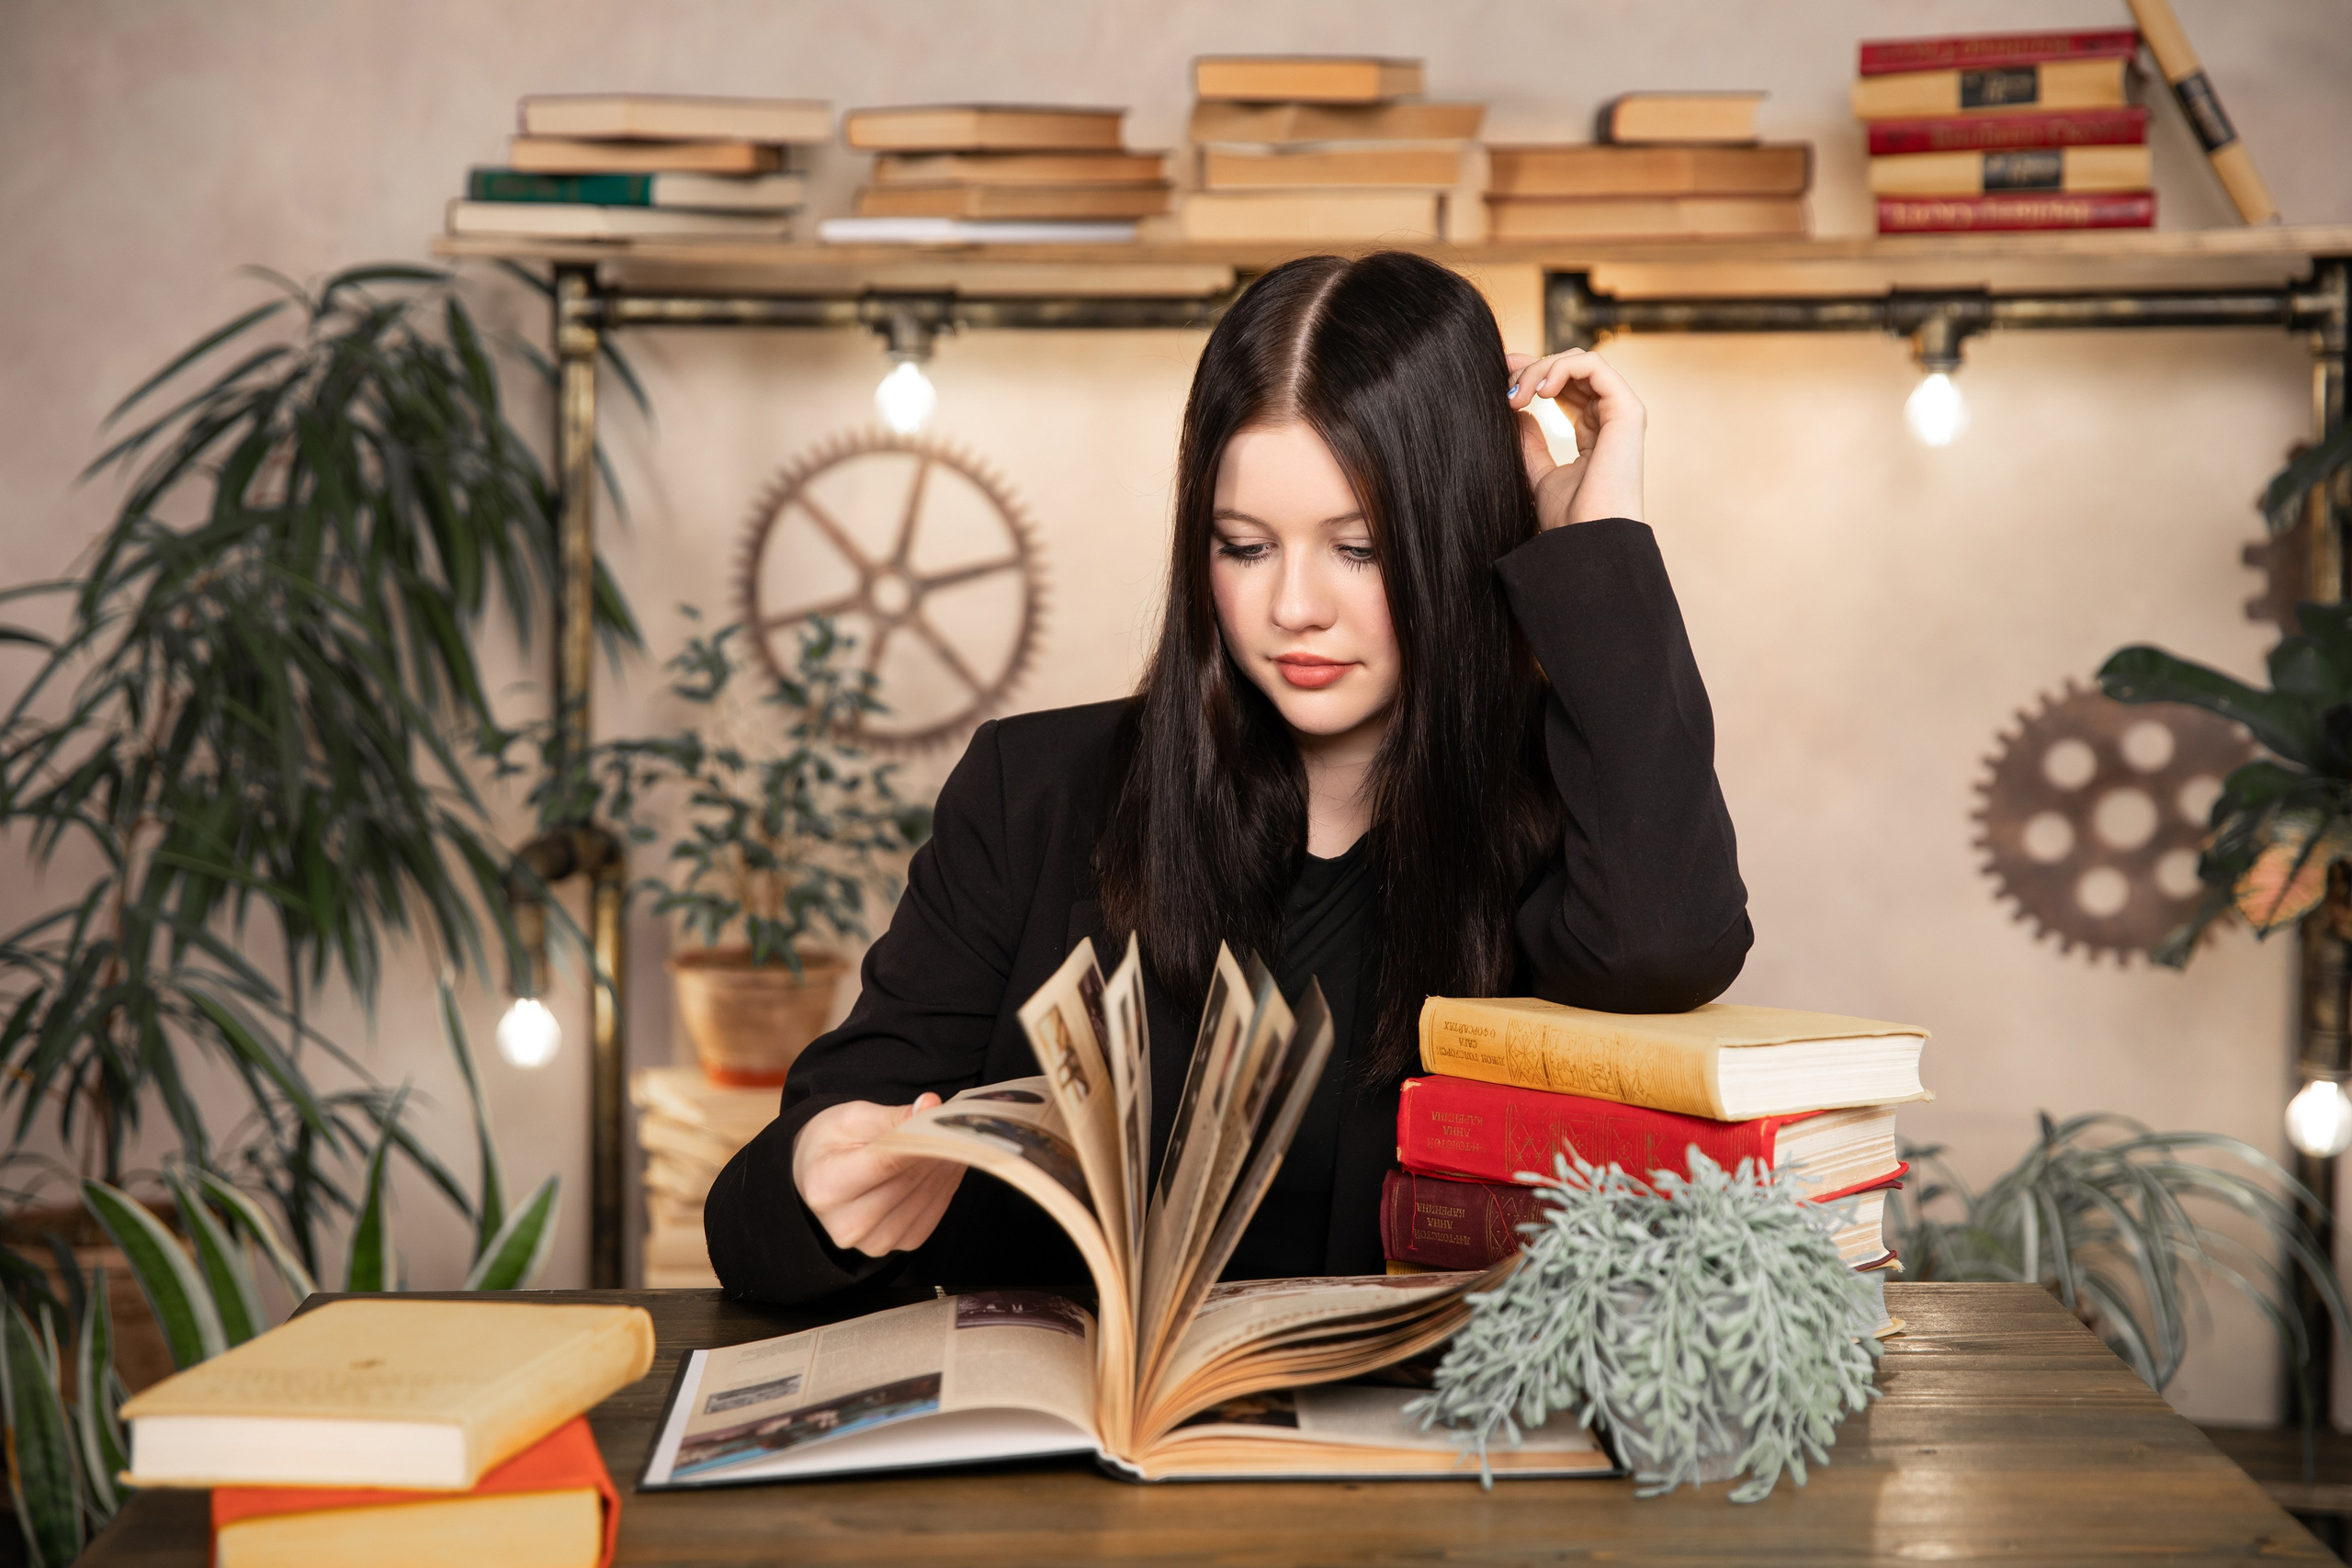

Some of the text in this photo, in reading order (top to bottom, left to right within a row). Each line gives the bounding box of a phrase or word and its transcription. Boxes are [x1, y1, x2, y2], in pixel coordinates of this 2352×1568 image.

[1443, 1021, 1496, 1039] О ФОРСАЙТАХ
[1458, 1037, 1477, 1049] САГА
[1481, 1055, 1505, 1066] ДЖОН
[1416, 1201, 1465, 1219] КАРЕНИНА
[1426, 1217, 1453, 1230] АННА
